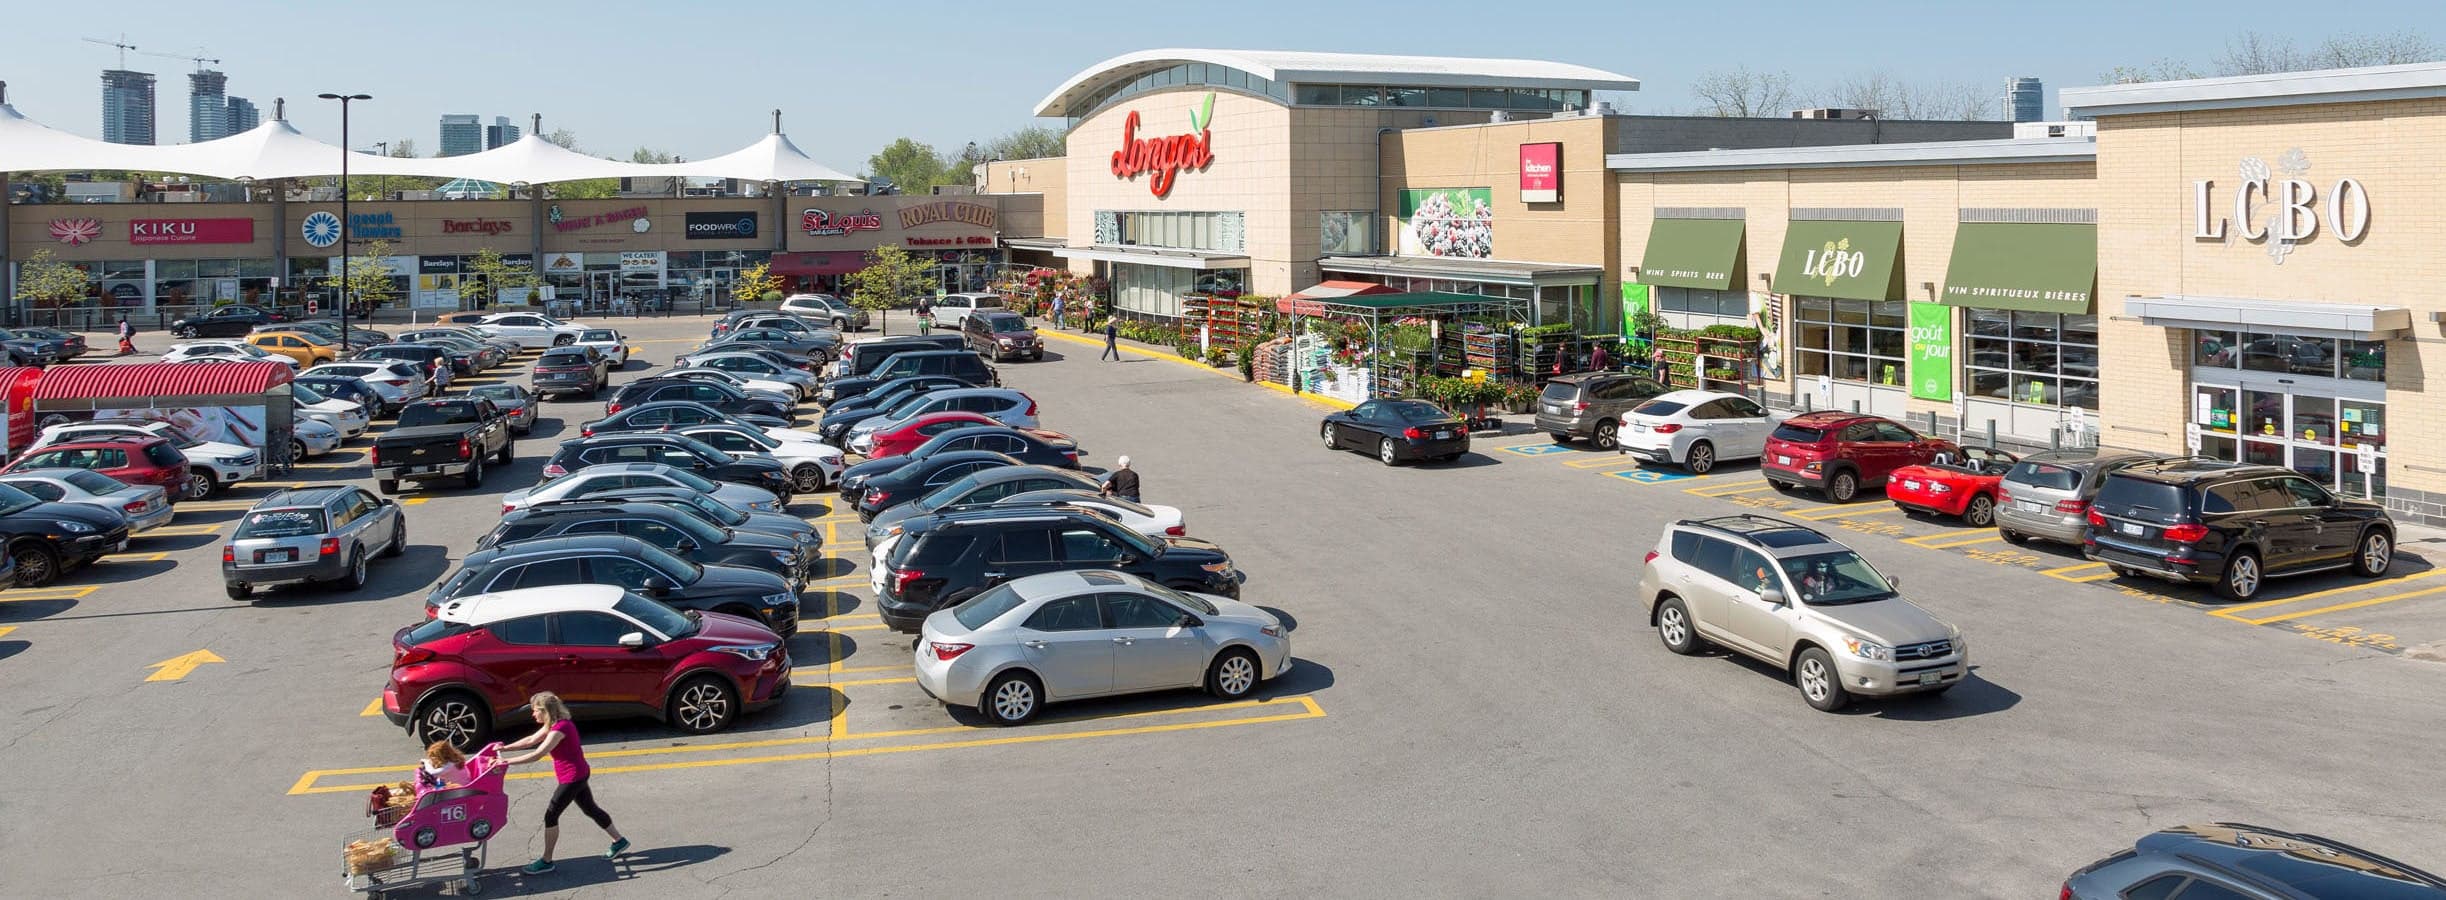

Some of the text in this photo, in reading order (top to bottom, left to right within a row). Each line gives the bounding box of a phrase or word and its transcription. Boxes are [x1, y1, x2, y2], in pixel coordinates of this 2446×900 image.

[902, 202, 995, 229] ROYAL CLUB
[2193, 177, 2369, 241] LCBO
[133, 222, 196, 235] KIKU
[442, 217, 512, 235] Barclays
[689, 223, 738, 231] FOODWRX
[907, 235, 992, 246] Tobacco & Gifts
[423, 260, 455, 268] Barclays
[502, 258, 532, 267] Barclays
[1803, 249, 1865, 278] LCBO
[1671, 271, 1699, 279] SPIRITS
[1949, 286, 2087, 302] VIN SPIRITUEUX BIÈRES
[1911, 324, 1944, 343] goût
[1922, 340, 1951, 360] jour
[444, 805, 464, 821] 16
